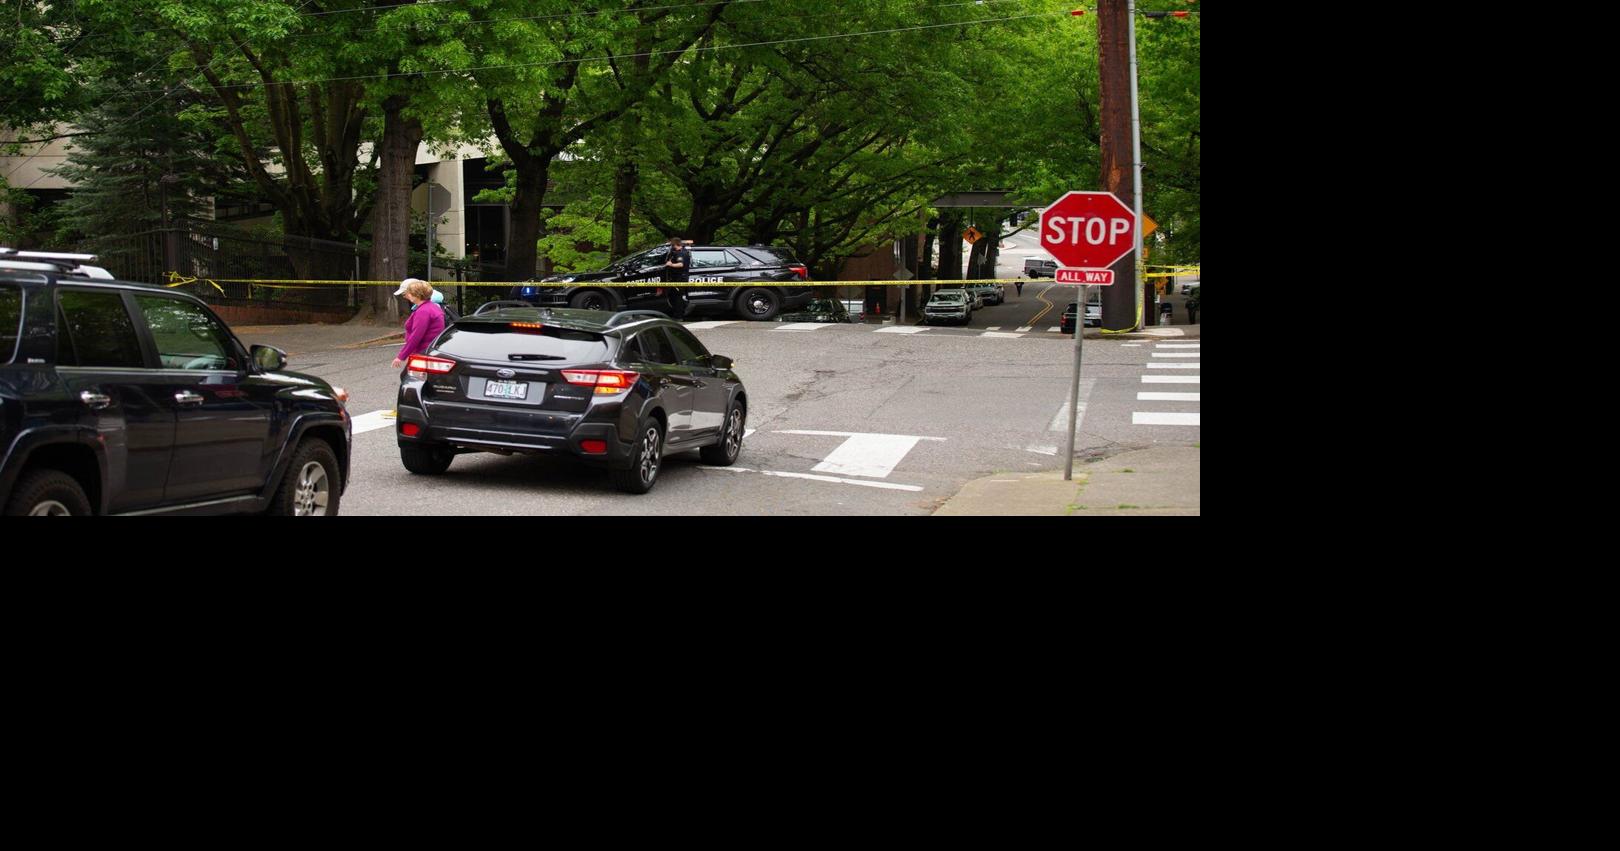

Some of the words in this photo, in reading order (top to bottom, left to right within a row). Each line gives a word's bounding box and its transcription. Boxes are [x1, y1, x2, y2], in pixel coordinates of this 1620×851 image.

[1045, 216, 1130, 246] STOP
[626, 276, 661, 287] RTLAND
[688, 276, 724, 284] POLICE
[1060, 271, 1081, 282] ALL
[1085, 272, 1108, 283] WAY
[486, 383, 504, 394] 470
